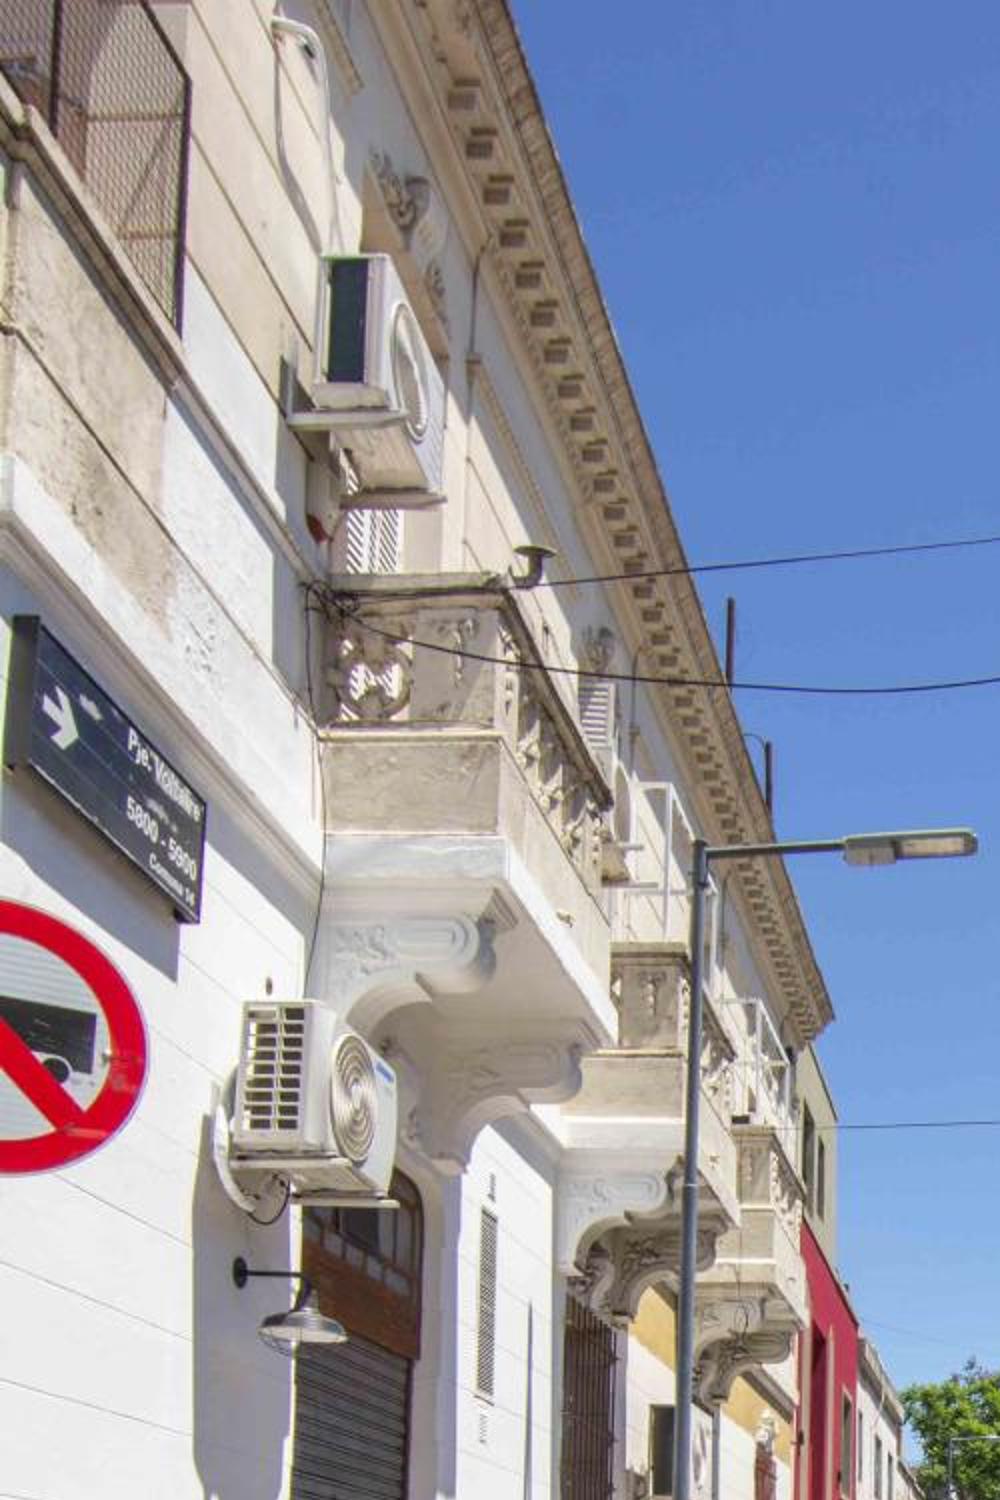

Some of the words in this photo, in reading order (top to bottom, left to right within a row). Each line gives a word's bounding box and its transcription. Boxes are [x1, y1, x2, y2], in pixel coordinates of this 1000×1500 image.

[127, 727, 153, 771] Pje.
[127, 795, 159, 844] 5800
[168, 837, 197, 881] 5900
